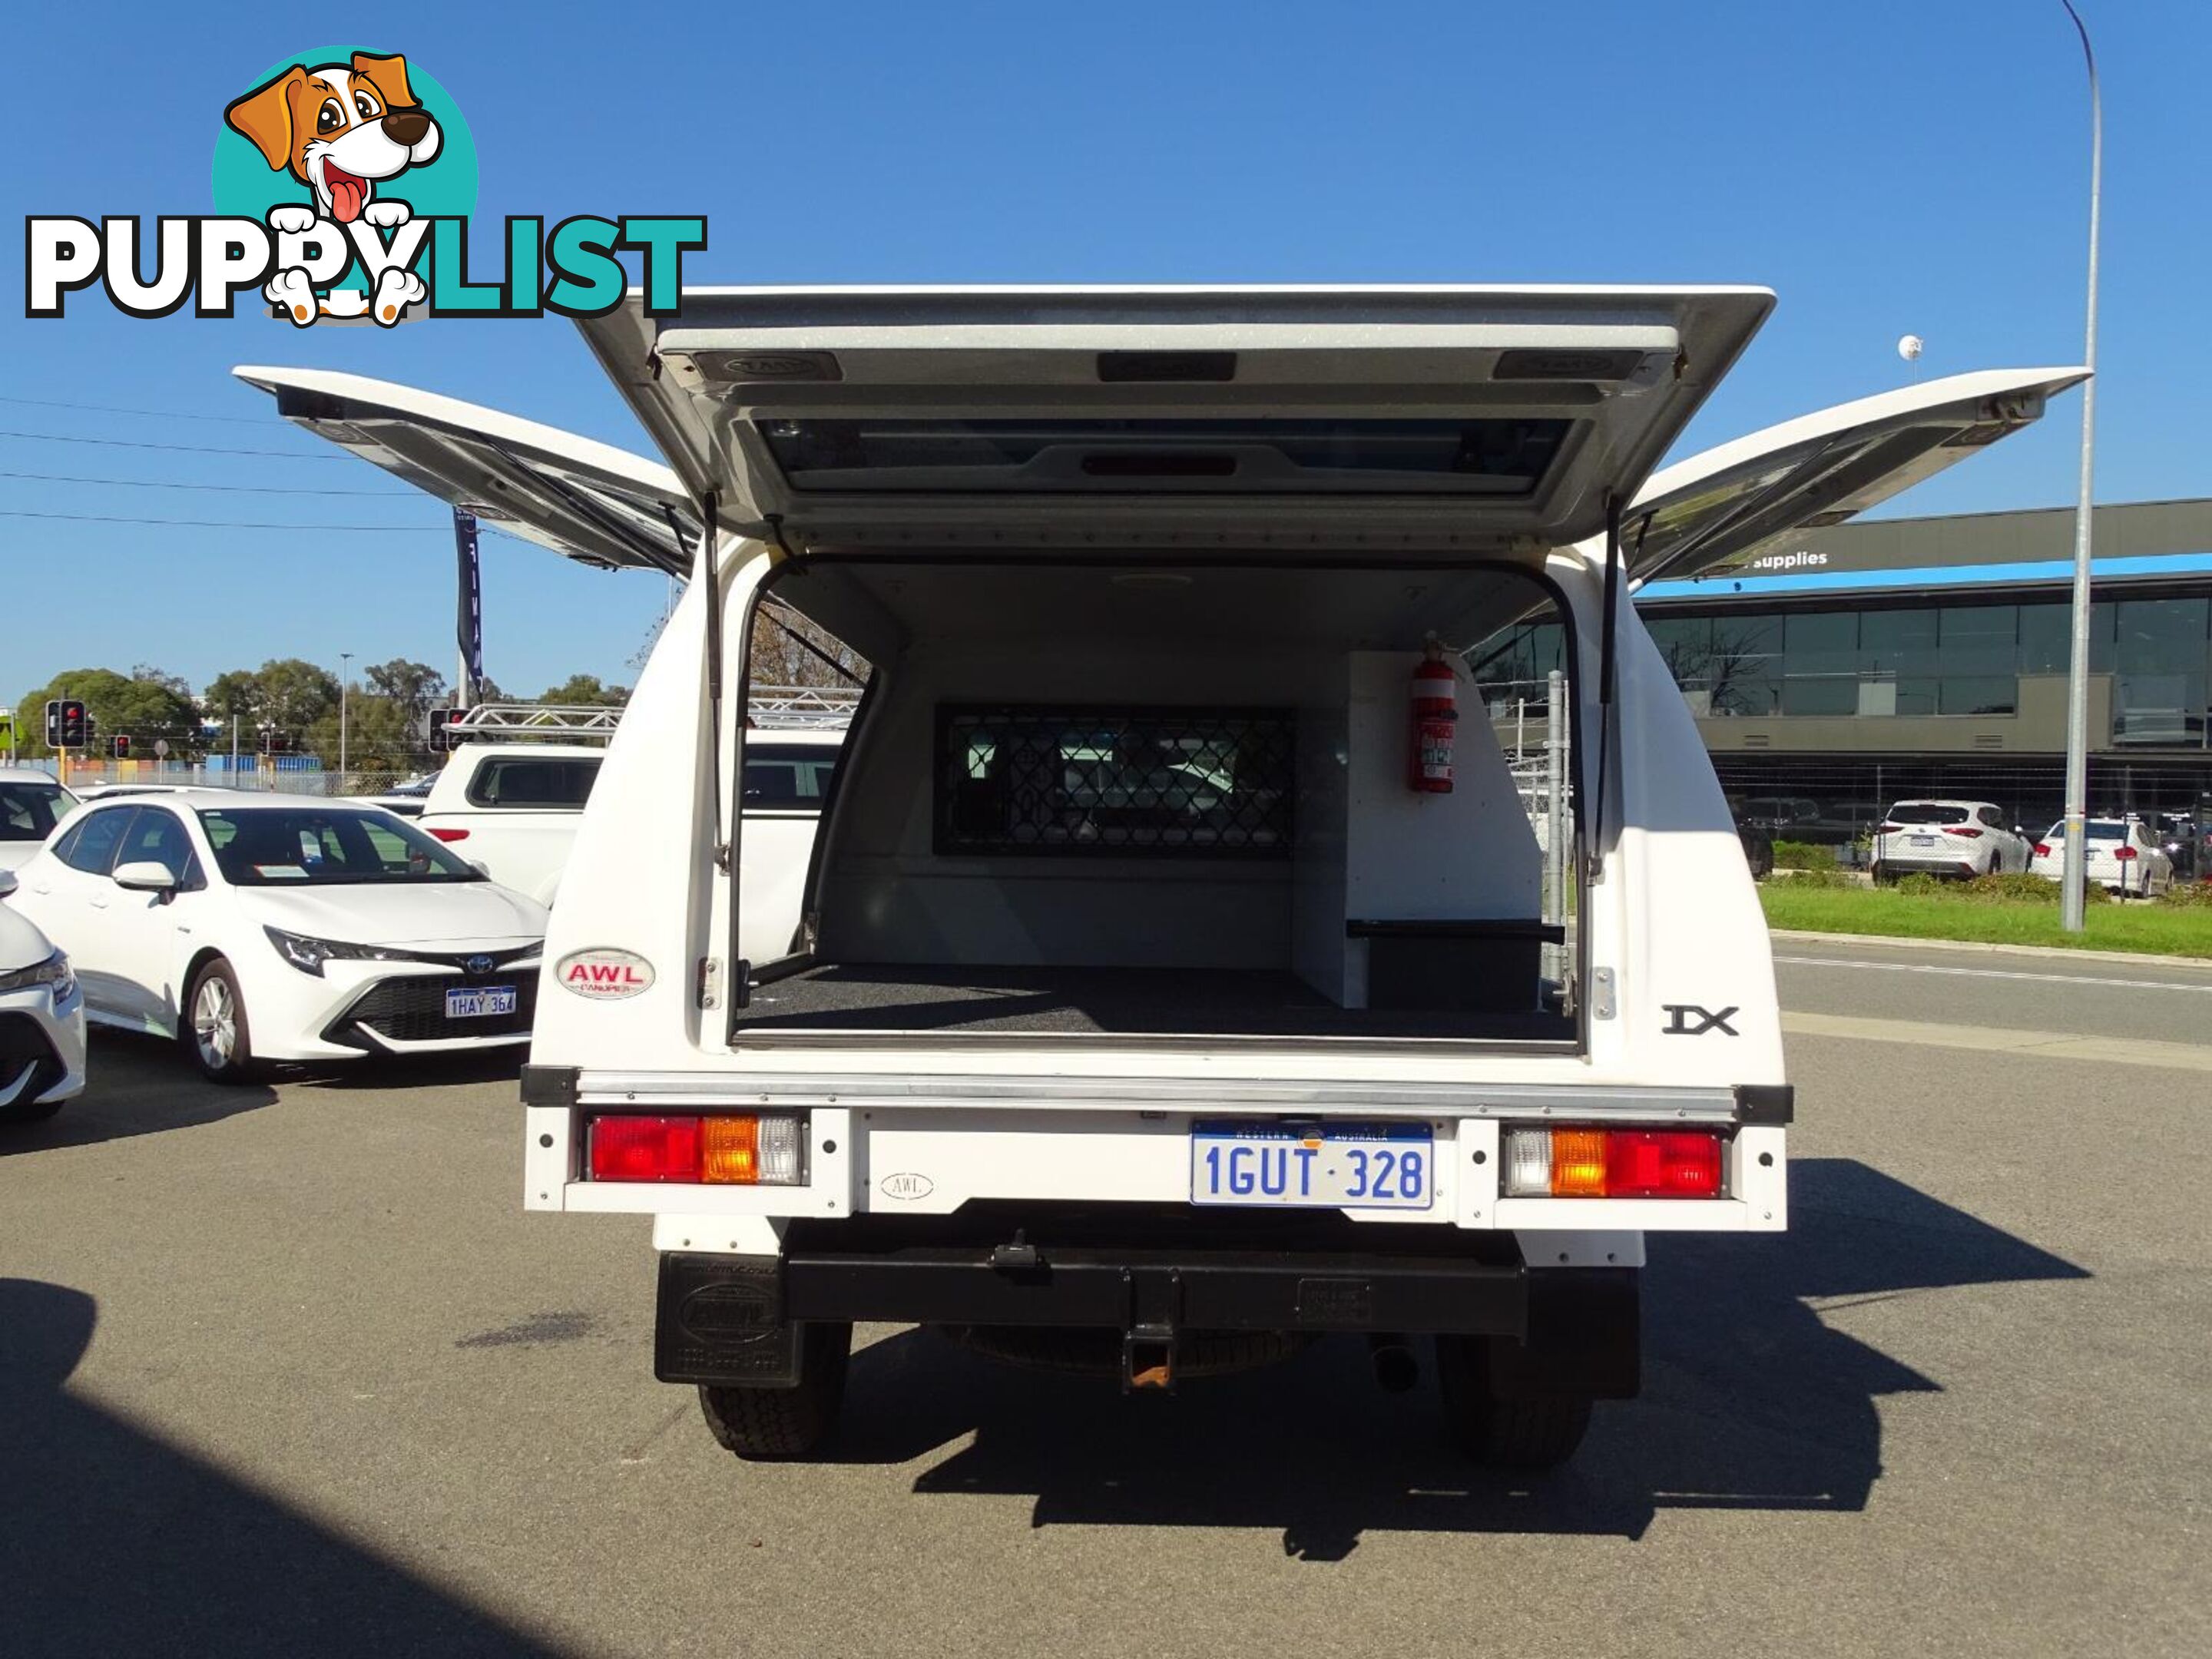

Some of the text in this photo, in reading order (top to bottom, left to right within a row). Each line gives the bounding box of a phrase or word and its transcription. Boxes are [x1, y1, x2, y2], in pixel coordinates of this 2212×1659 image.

[1753, 551, 1827, 569] supplies
[568, 964, 644, 982] AWL
[452, 995, 513, 1015] 1HAY 364
[1206, 1146, 1422, 1198] 1GUT 328
